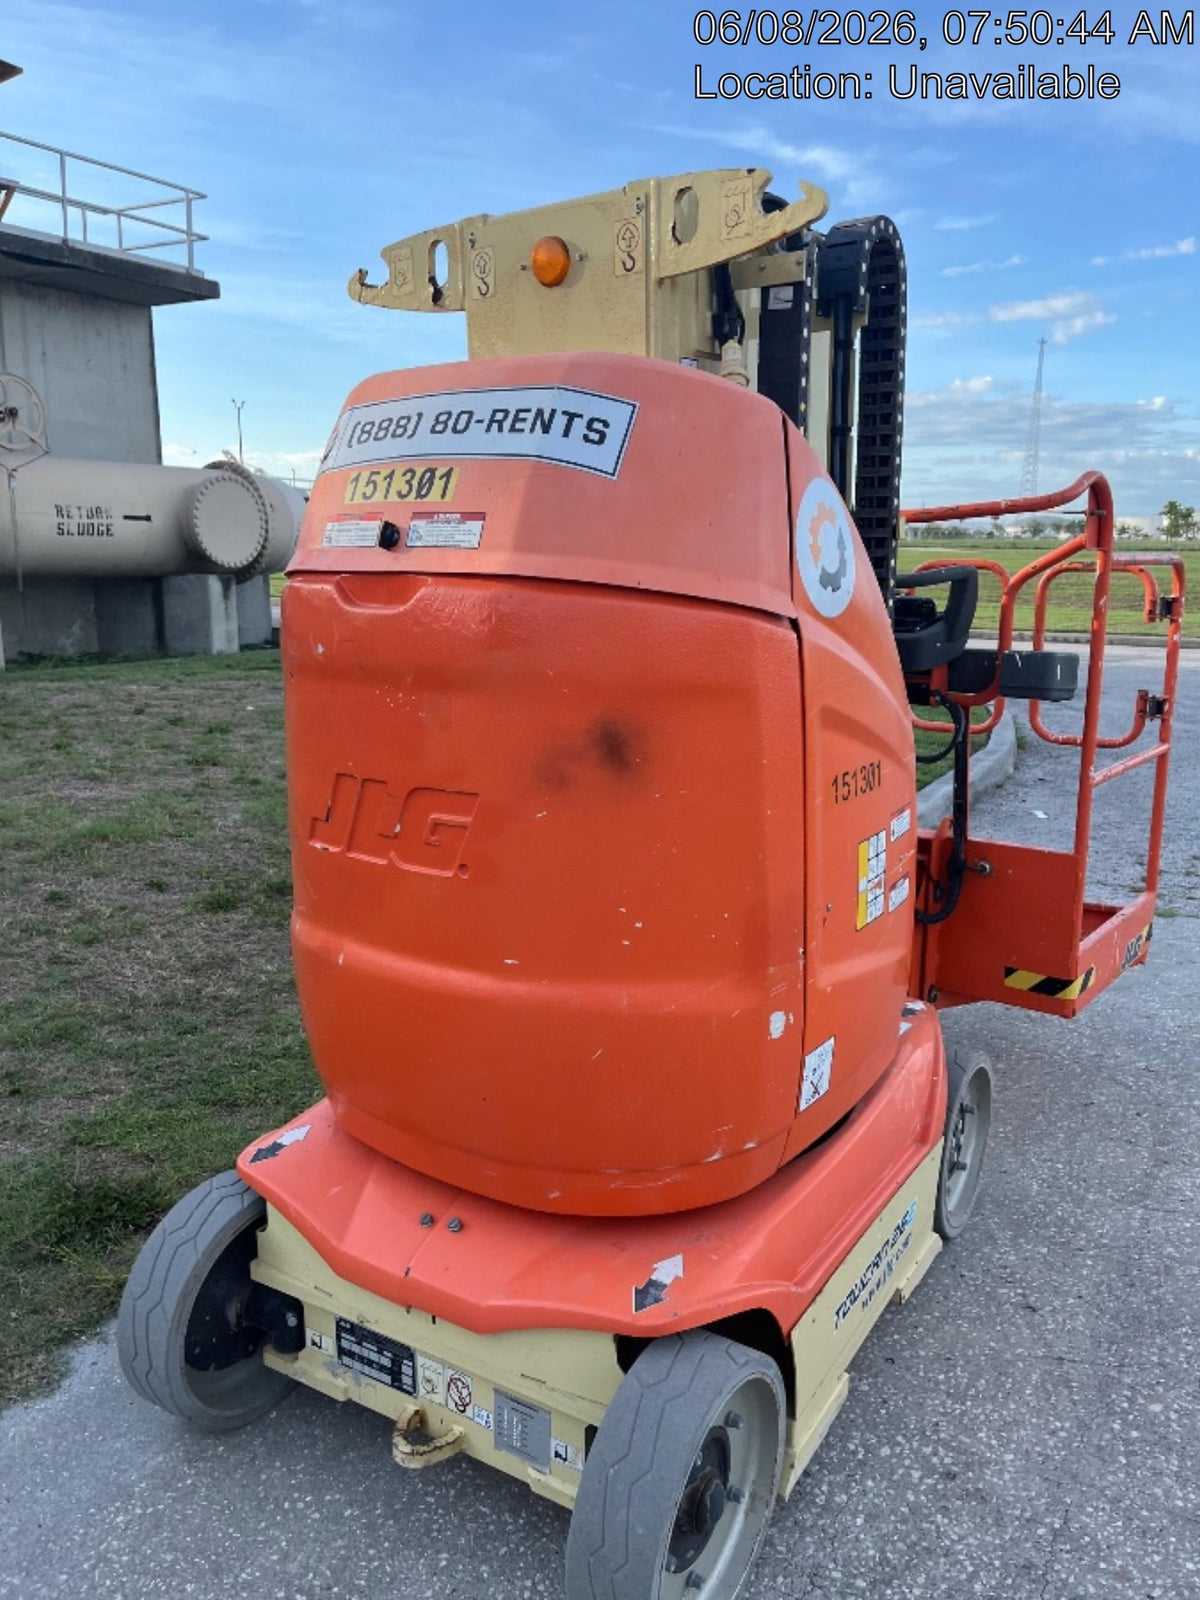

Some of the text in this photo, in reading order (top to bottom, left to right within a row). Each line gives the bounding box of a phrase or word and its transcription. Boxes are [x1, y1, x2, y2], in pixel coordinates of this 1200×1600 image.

[347, 407, 611, 448] (888) 80-RENTS
[350, 467, 454, 501] 151301
[57, 522, 114, 537] SLUDGE
[832, 760, 881, 804] 151301
